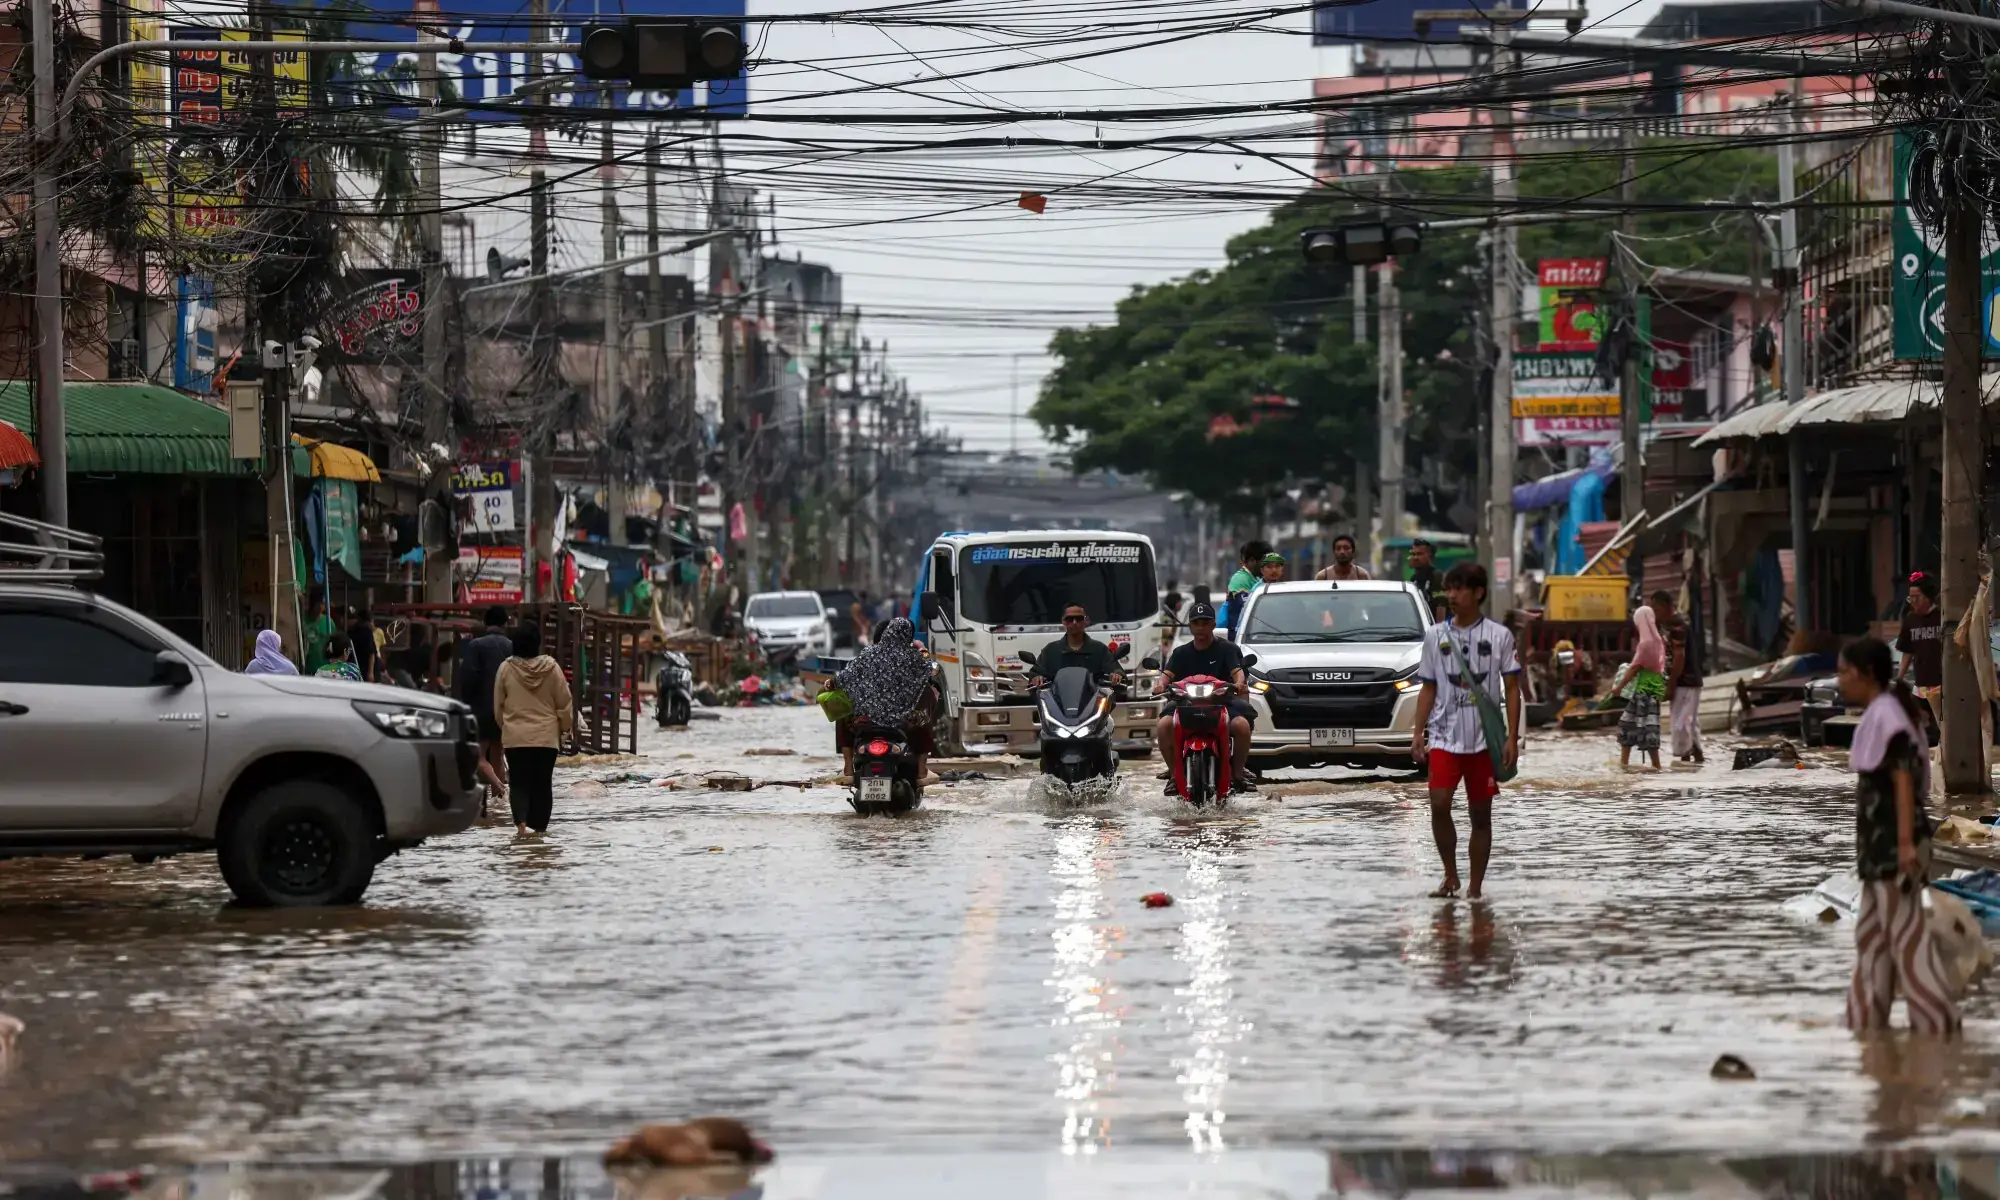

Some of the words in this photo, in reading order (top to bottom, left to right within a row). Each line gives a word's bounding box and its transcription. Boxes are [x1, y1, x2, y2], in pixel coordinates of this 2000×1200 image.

[1197, 606, 1204, 614] C
[1312, 672, 1351, 680] ISUZU
[1331, 729, 1352, 738] 8761
